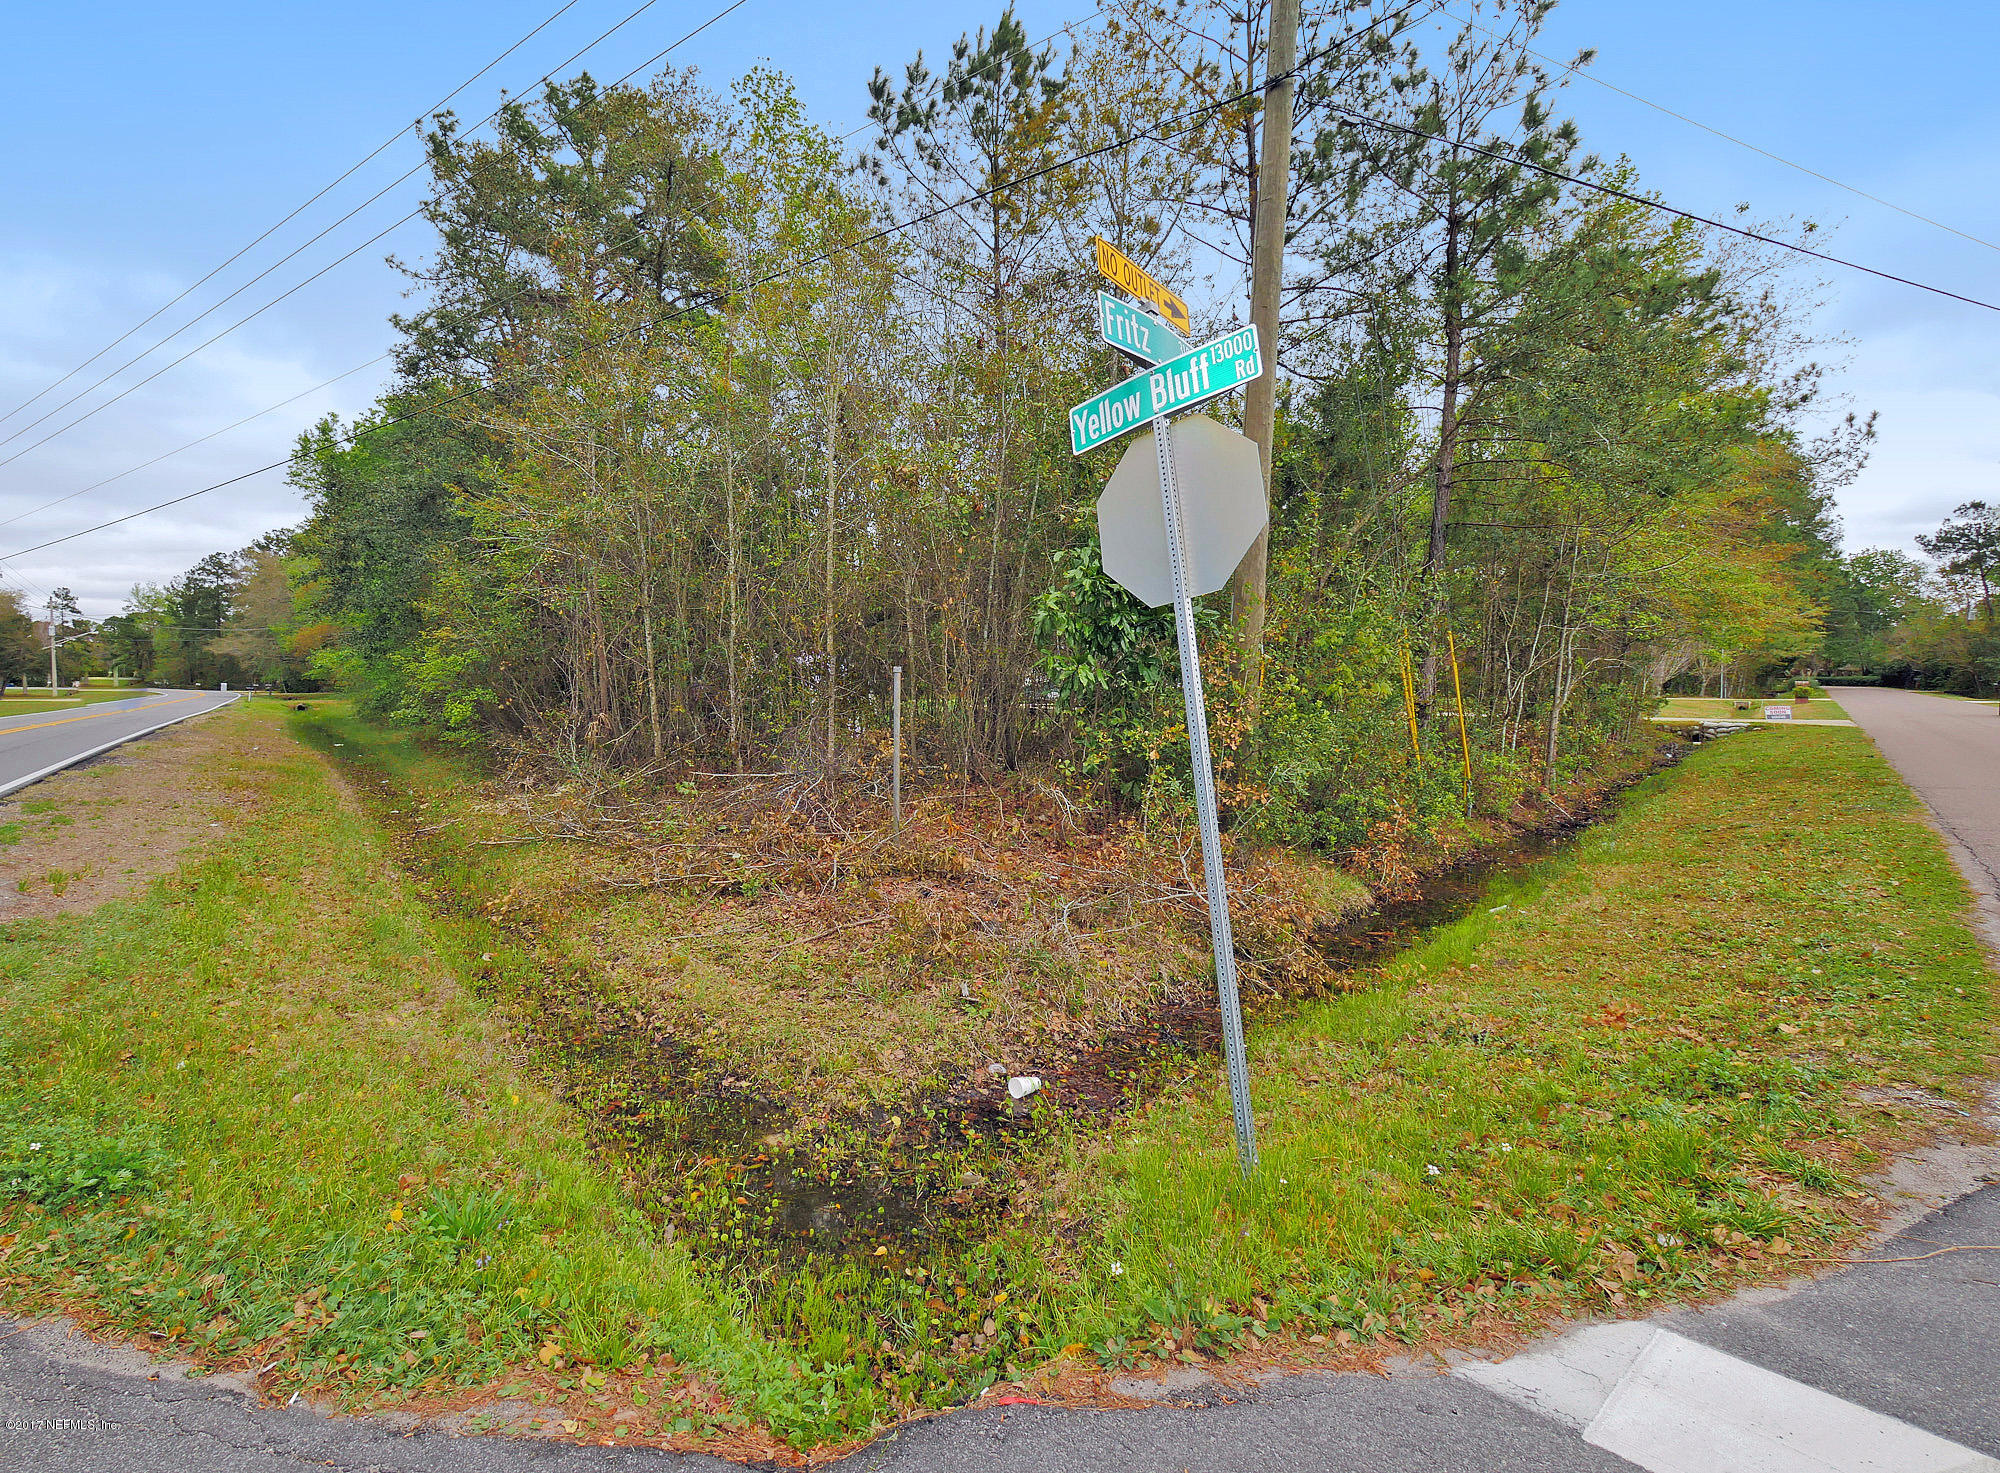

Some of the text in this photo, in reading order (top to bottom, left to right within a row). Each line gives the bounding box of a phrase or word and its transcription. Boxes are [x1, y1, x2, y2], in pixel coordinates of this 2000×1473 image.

[1102, 245, 1160, 308] NO OUTLET
[1104, 299, 1151, 354] Fritz
[1210, 331, 1253, 365] 13000
[1073, 352, 1256, 445] Yellow Bluff Rd
